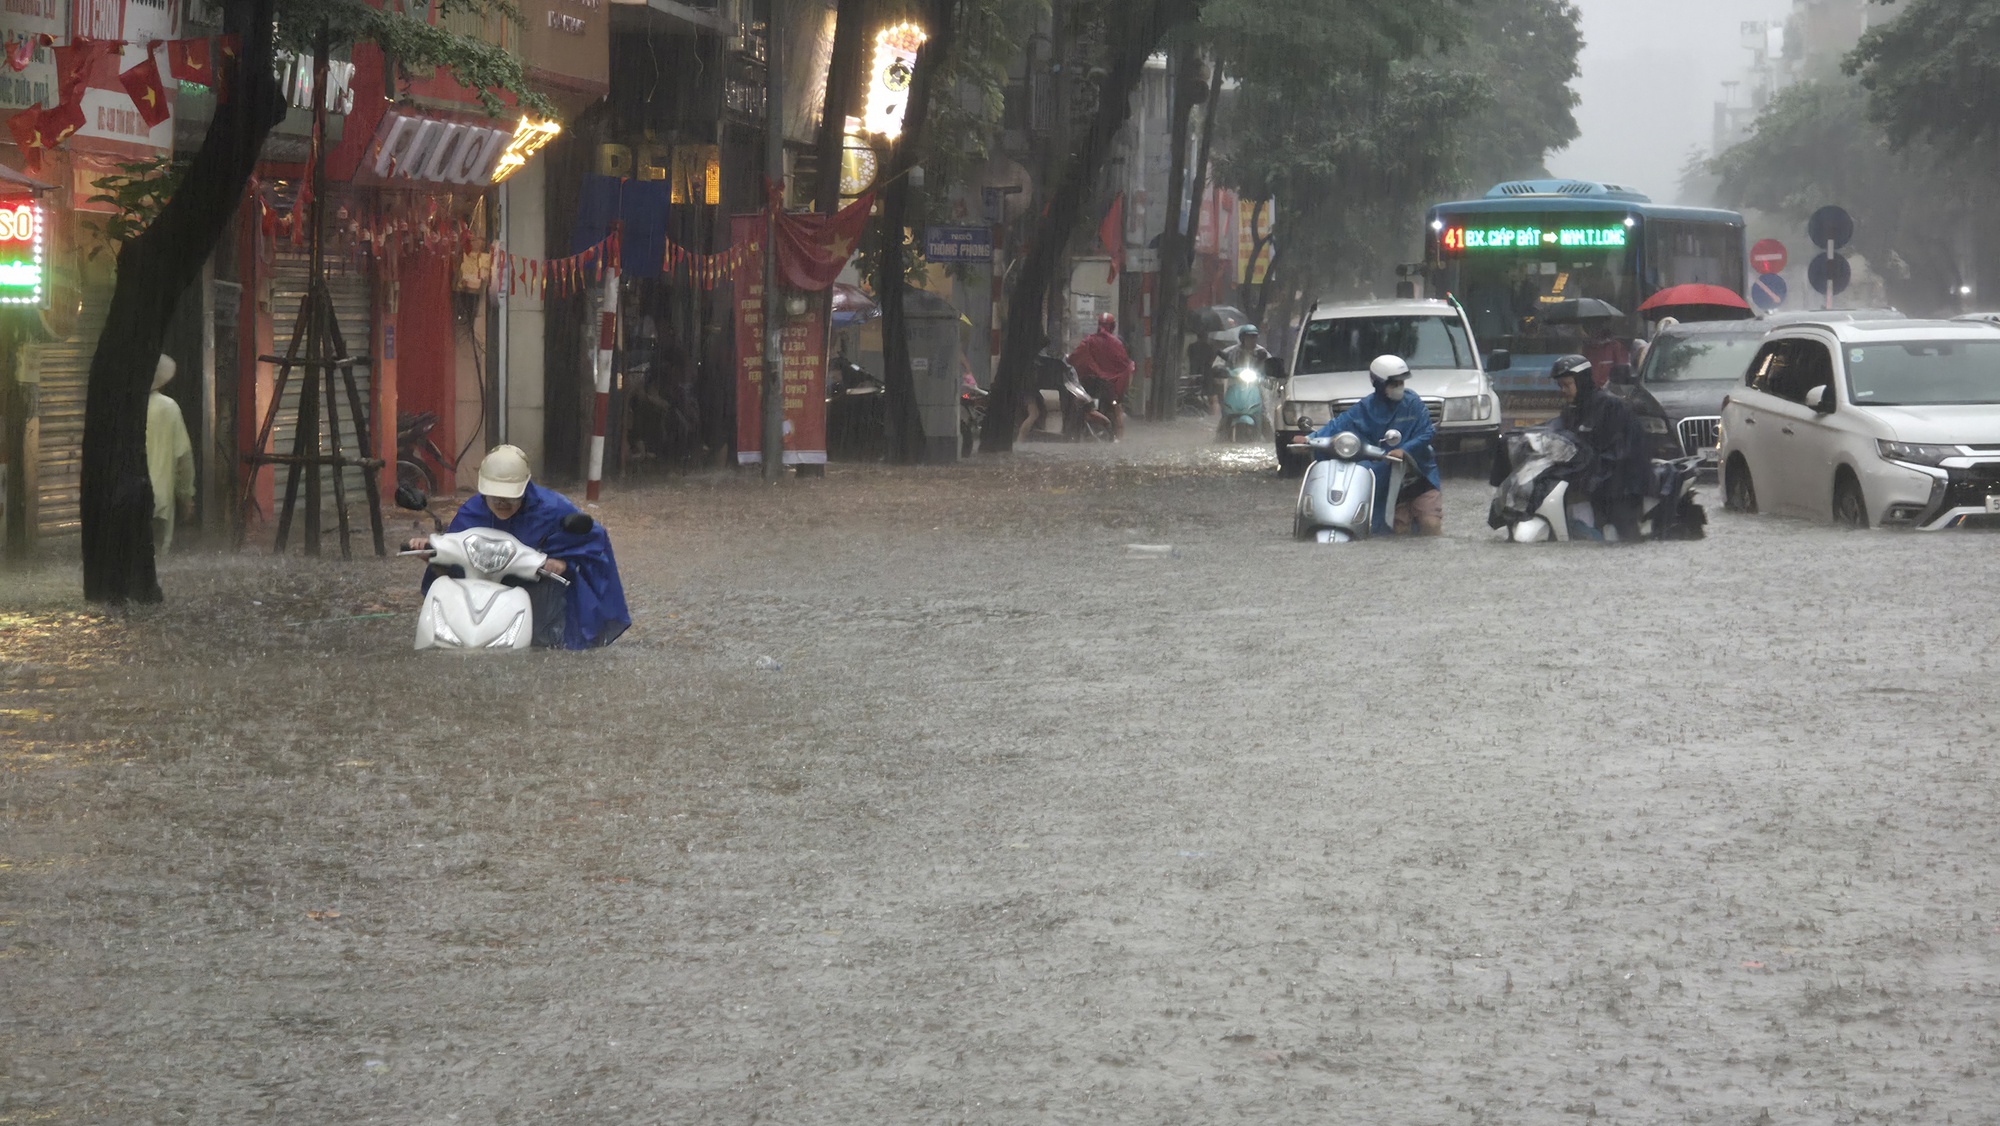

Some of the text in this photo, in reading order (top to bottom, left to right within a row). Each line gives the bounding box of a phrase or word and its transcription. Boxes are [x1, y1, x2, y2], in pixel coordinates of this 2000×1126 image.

[1445, 228, 1464, 248] 41
[1516, 227, 1542, 246] BÁT
[929, 241, 990, 257] THÔNG PHONG
